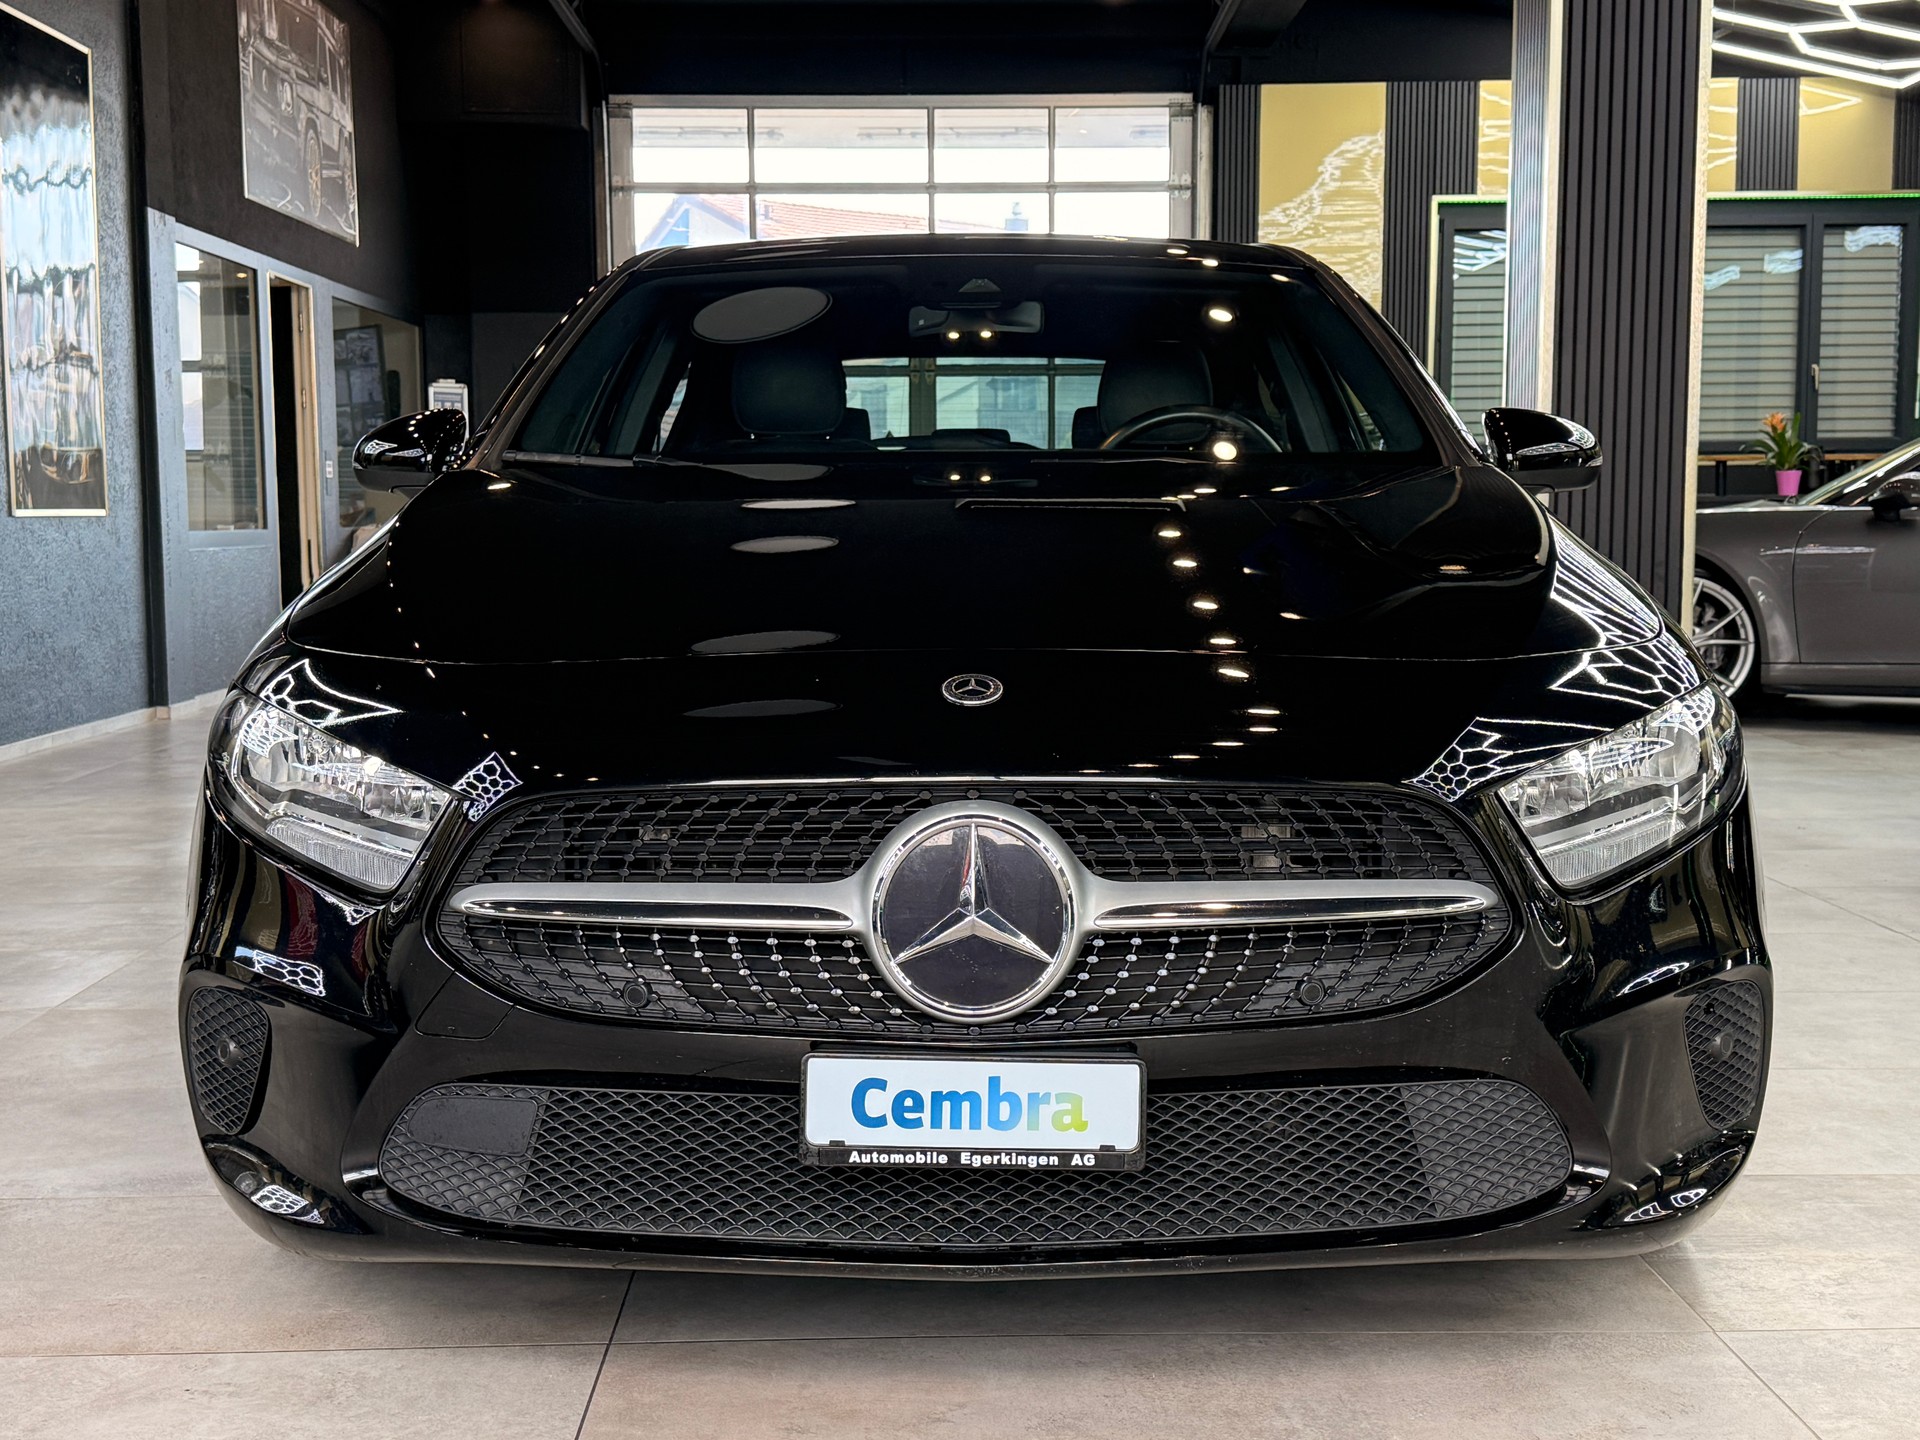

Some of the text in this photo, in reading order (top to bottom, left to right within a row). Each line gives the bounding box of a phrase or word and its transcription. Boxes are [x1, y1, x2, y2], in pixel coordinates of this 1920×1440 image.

[851, 1076, 1089, 1132] Cembra
[848, 1150, 1096, 1168] Automobile Egerkingen AG
